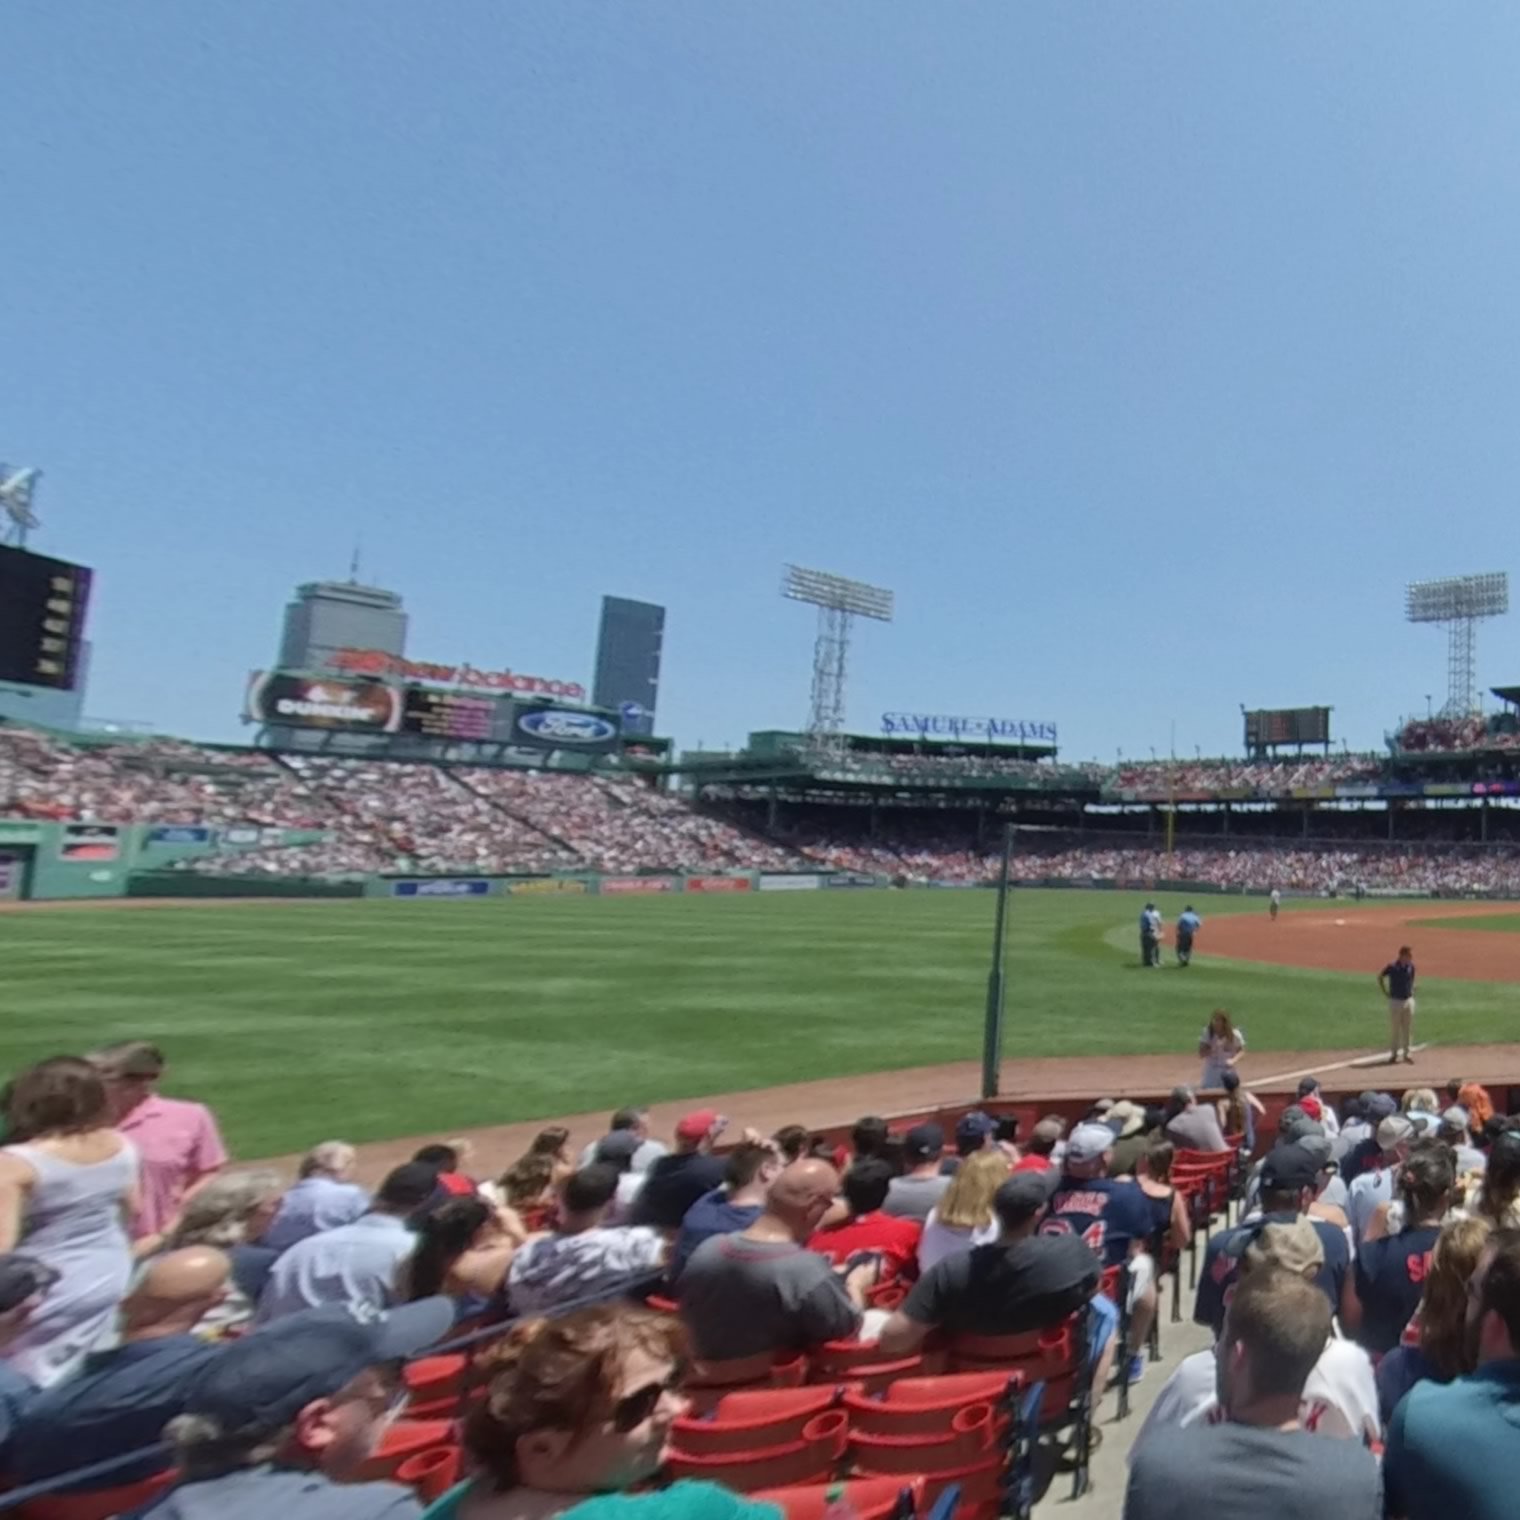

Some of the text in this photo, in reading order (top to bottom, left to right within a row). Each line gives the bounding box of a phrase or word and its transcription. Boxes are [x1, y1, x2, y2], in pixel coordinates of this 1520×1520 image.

[458, 662, 586, 698] balance
[538, 713, 598, 738] Ford
[881, 711, 1057, 741] SAMUEL ADAMS
